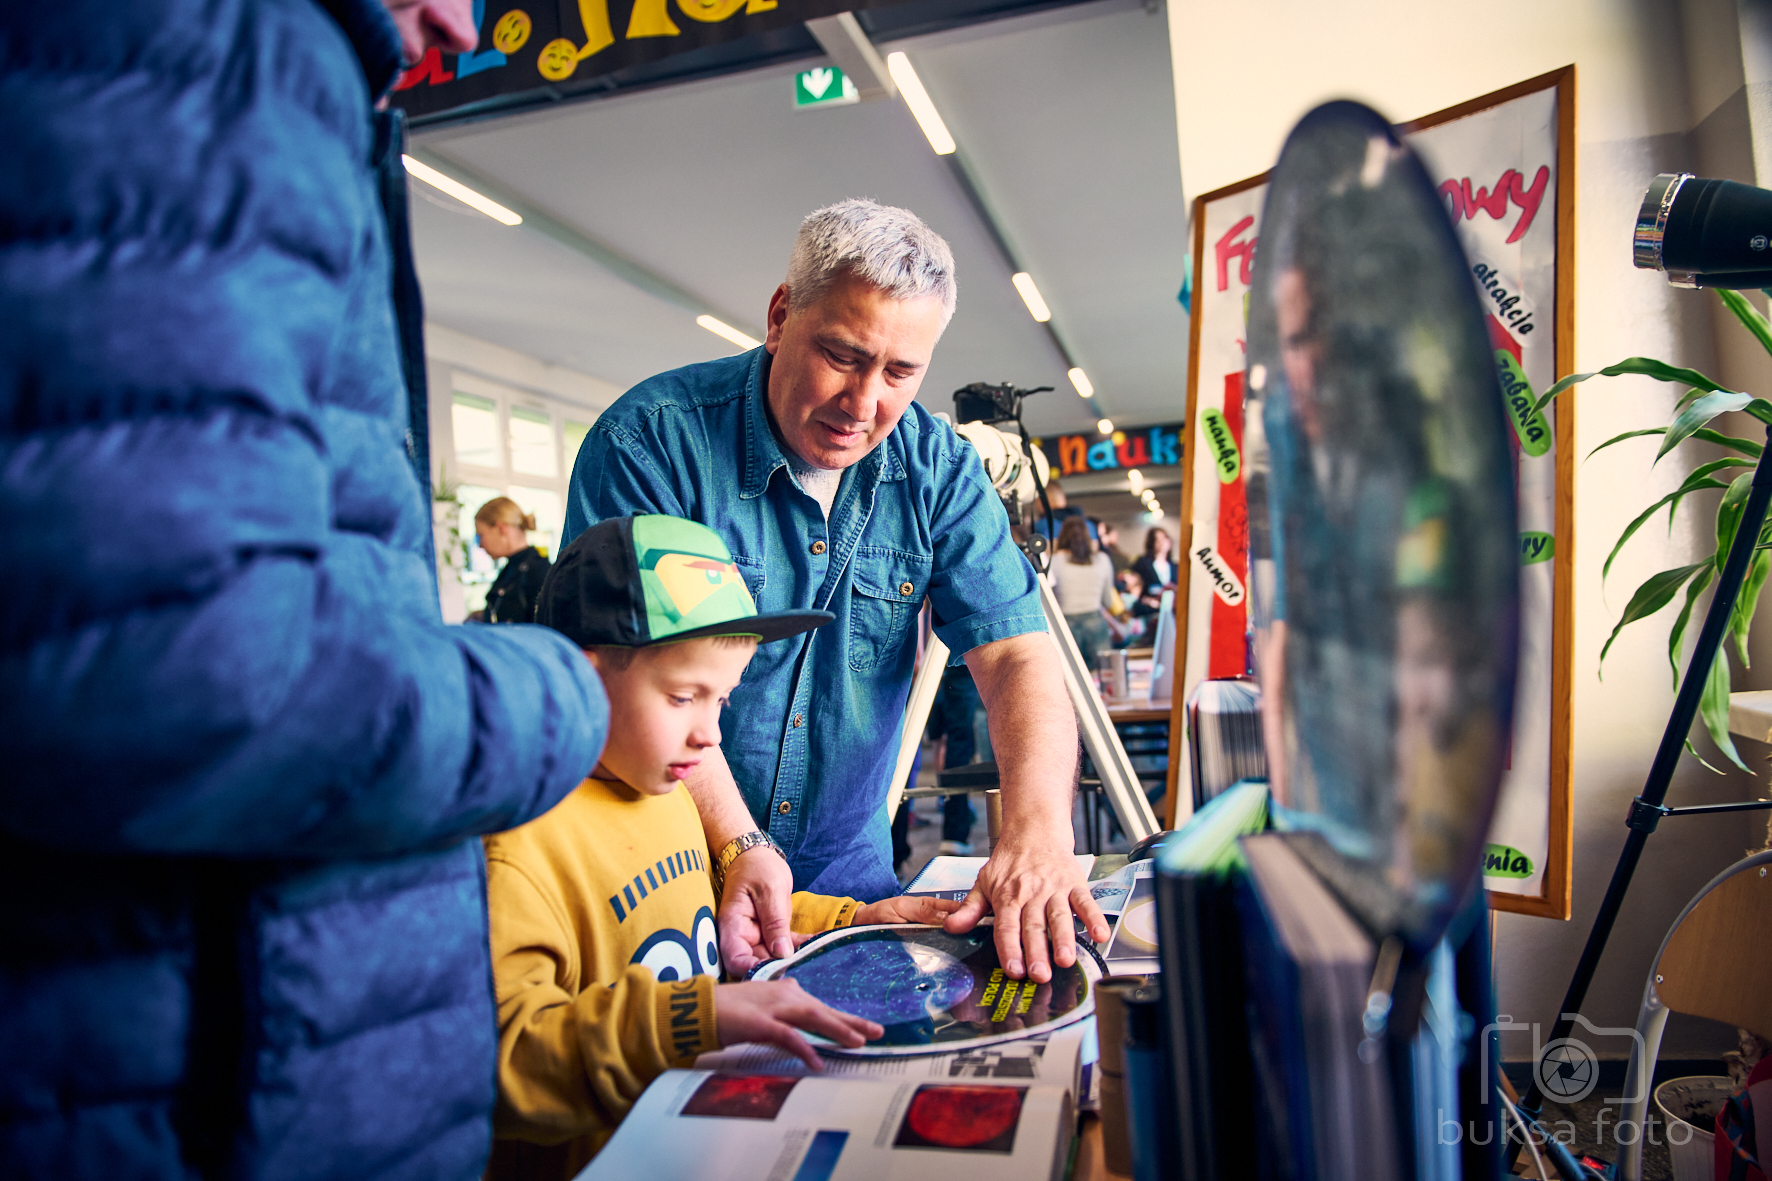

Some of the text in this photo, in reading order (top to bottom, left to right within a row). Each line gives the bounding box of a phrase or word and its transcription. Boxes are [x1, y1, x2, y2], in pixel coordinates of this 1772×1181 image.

[1473, 263, 1534, 335] atrakcje
[1206, 415, 1237, 474] nauka
[1197, 547, 1239, 599] humor
[1521, 536, 1547, 559] ry
